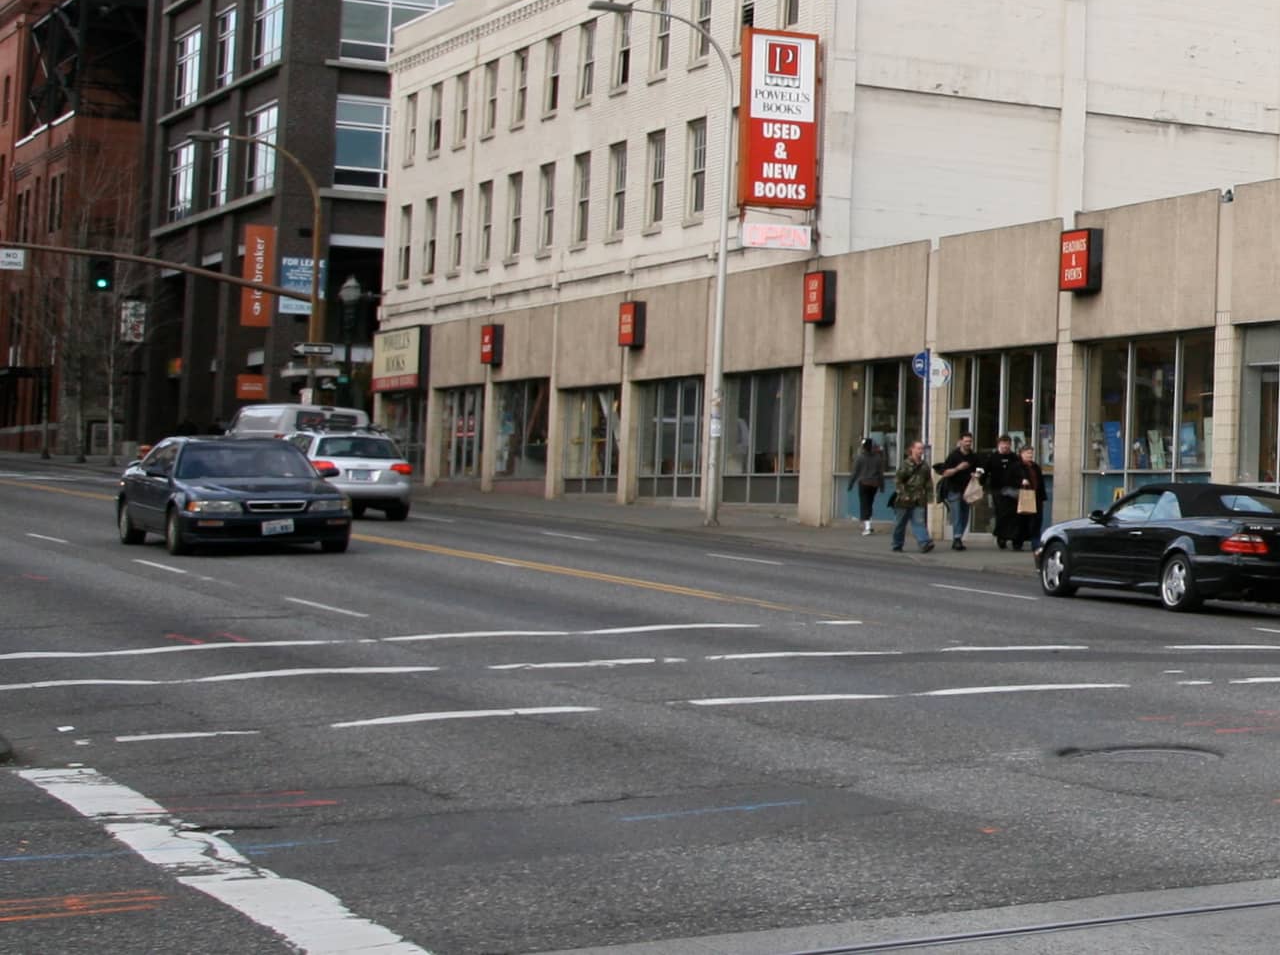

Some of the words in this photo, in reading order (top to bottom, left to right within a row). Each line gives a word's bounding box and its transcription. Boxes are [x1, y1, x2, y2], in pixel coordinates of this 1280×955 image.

[755, 89, 810, 103] POWELL'S
[763, 102, 802, 115] BOOKS
[763, 122, 801, 140] USED
[774, 141, 788, 159] &
[762, 162, 797, 180] NEW
[754, 181, 806, 201] BOOKS
[252, 236, 265, 299] icbreaker
[282, 257, 299, 267] FOR
